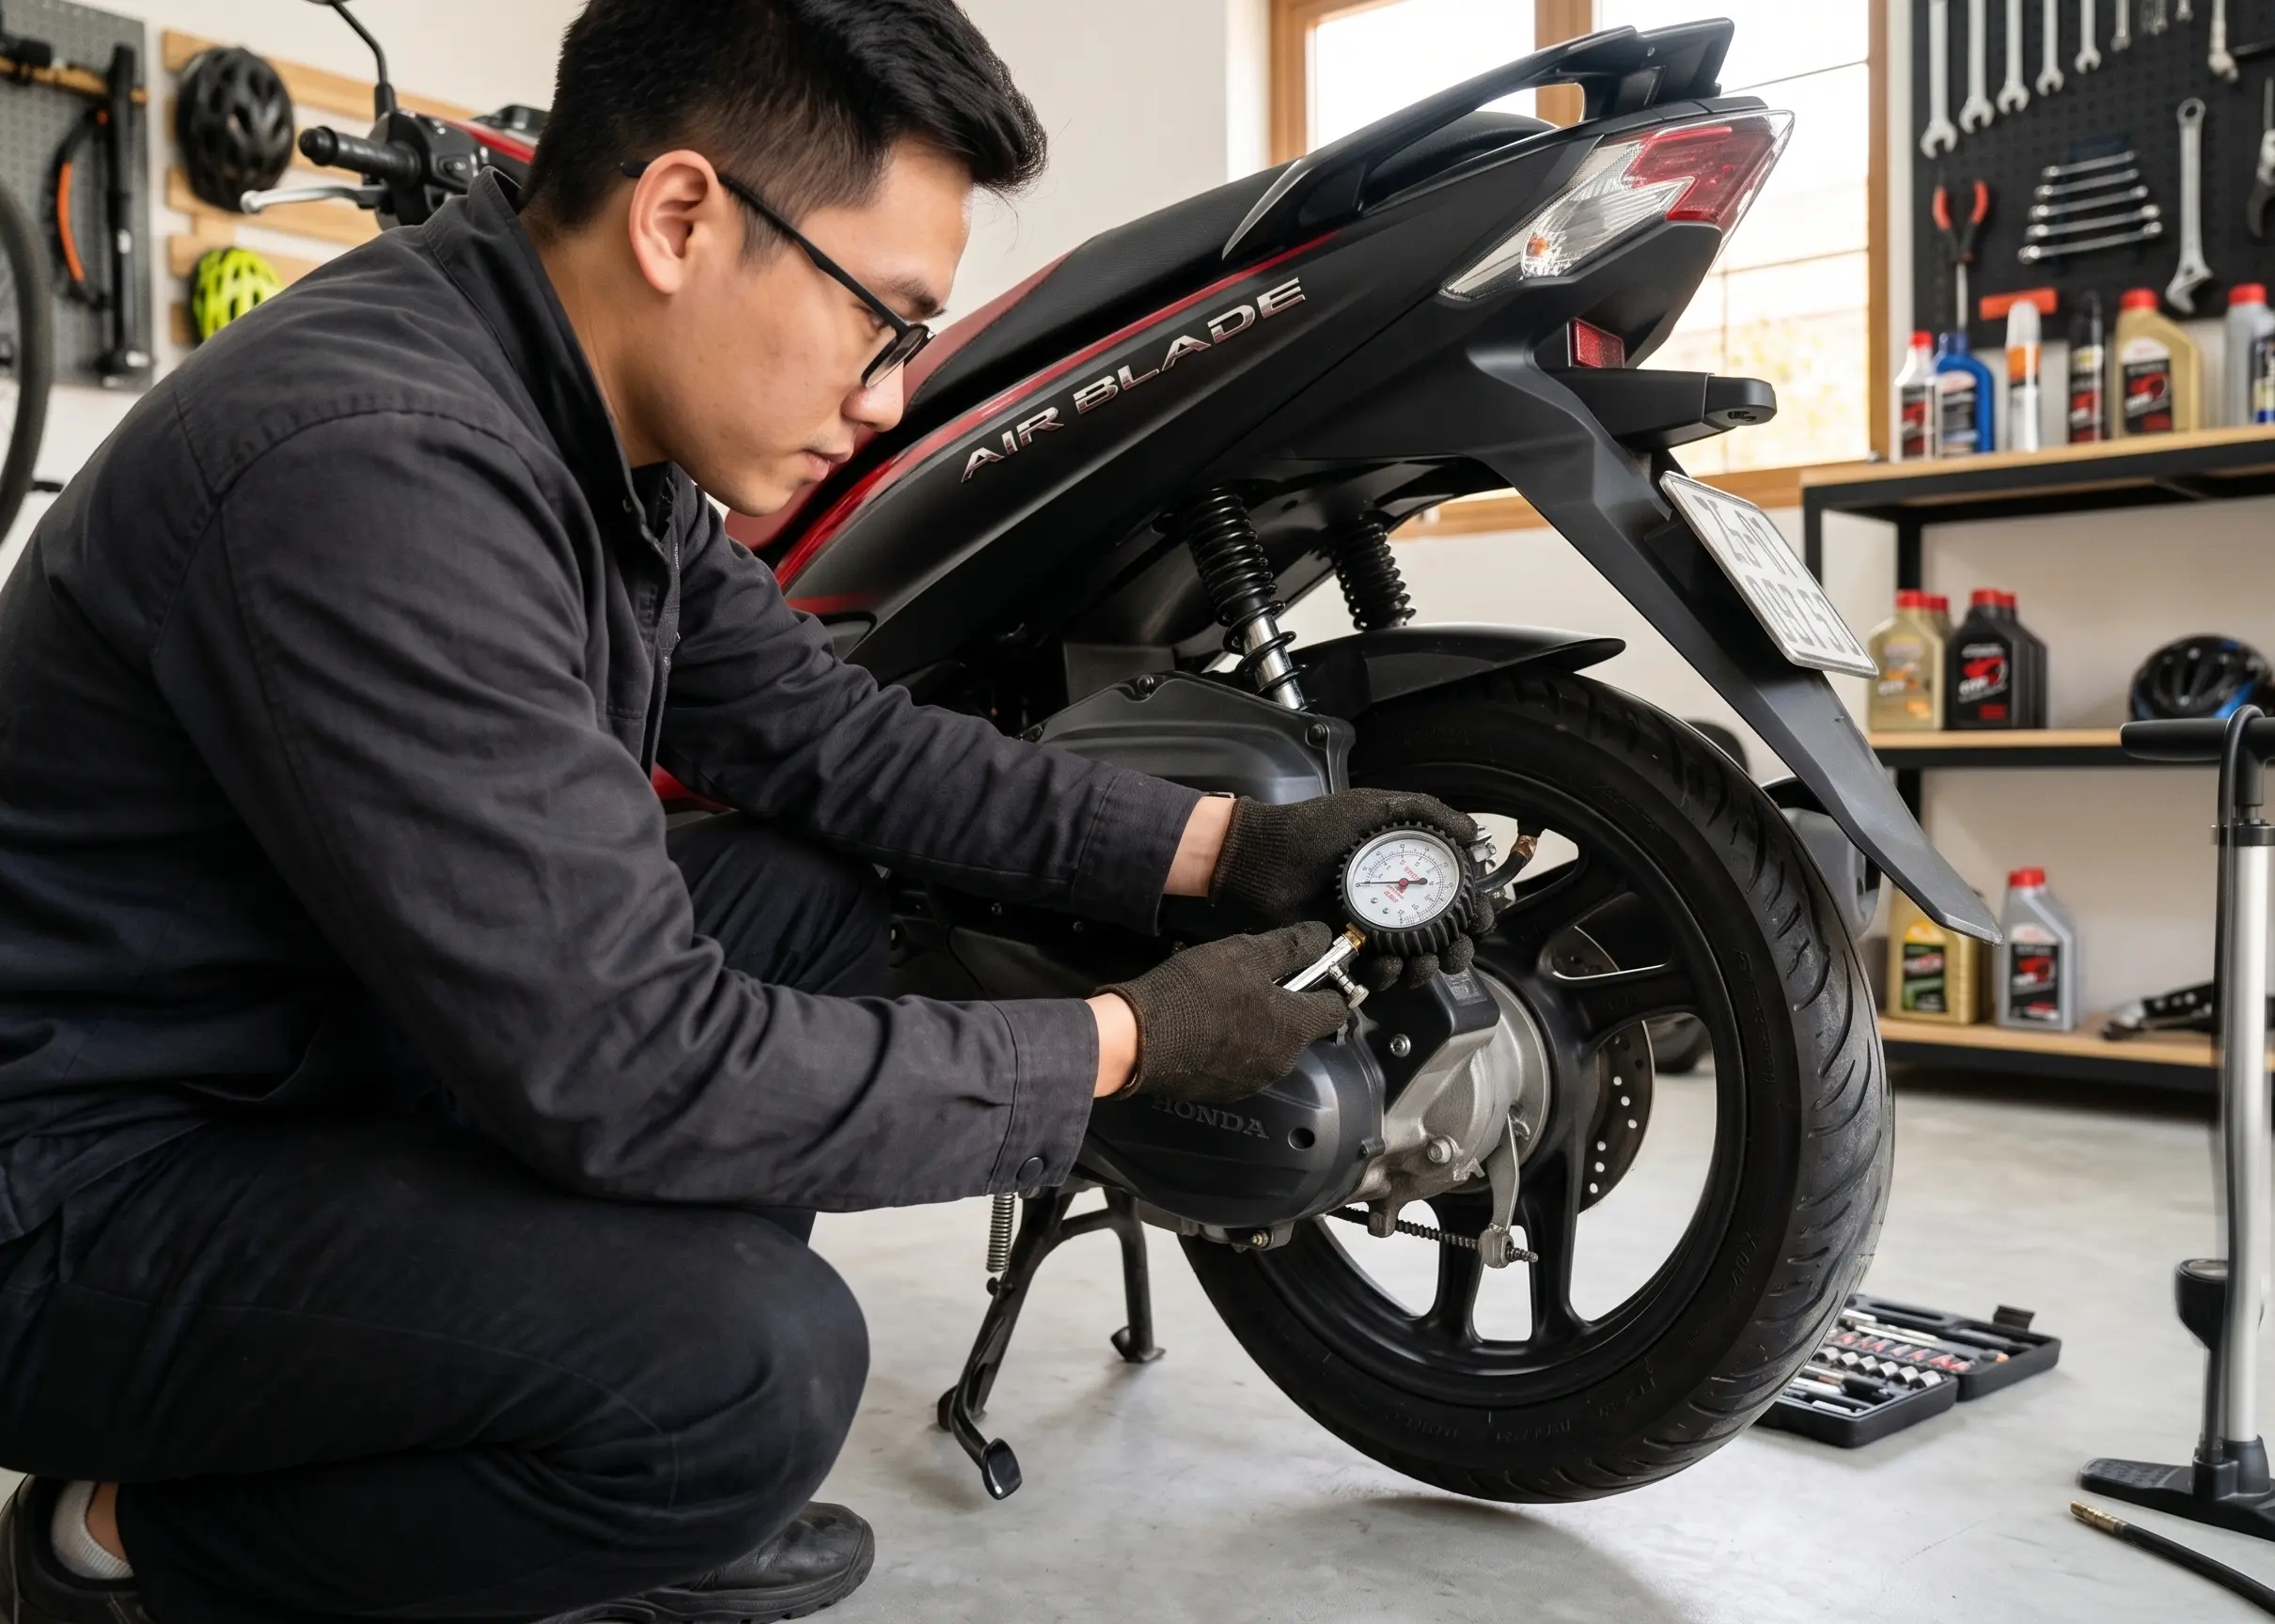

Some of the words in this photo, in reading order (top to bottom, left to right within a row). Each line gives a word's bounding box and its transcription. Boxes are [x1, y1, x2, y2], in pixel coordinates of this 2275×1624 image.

[961, 406, 1064, 483] AIR
[1073, 277, 1306, 414] BLADE
[1151, 1093, 1269, 1140] HONDA
